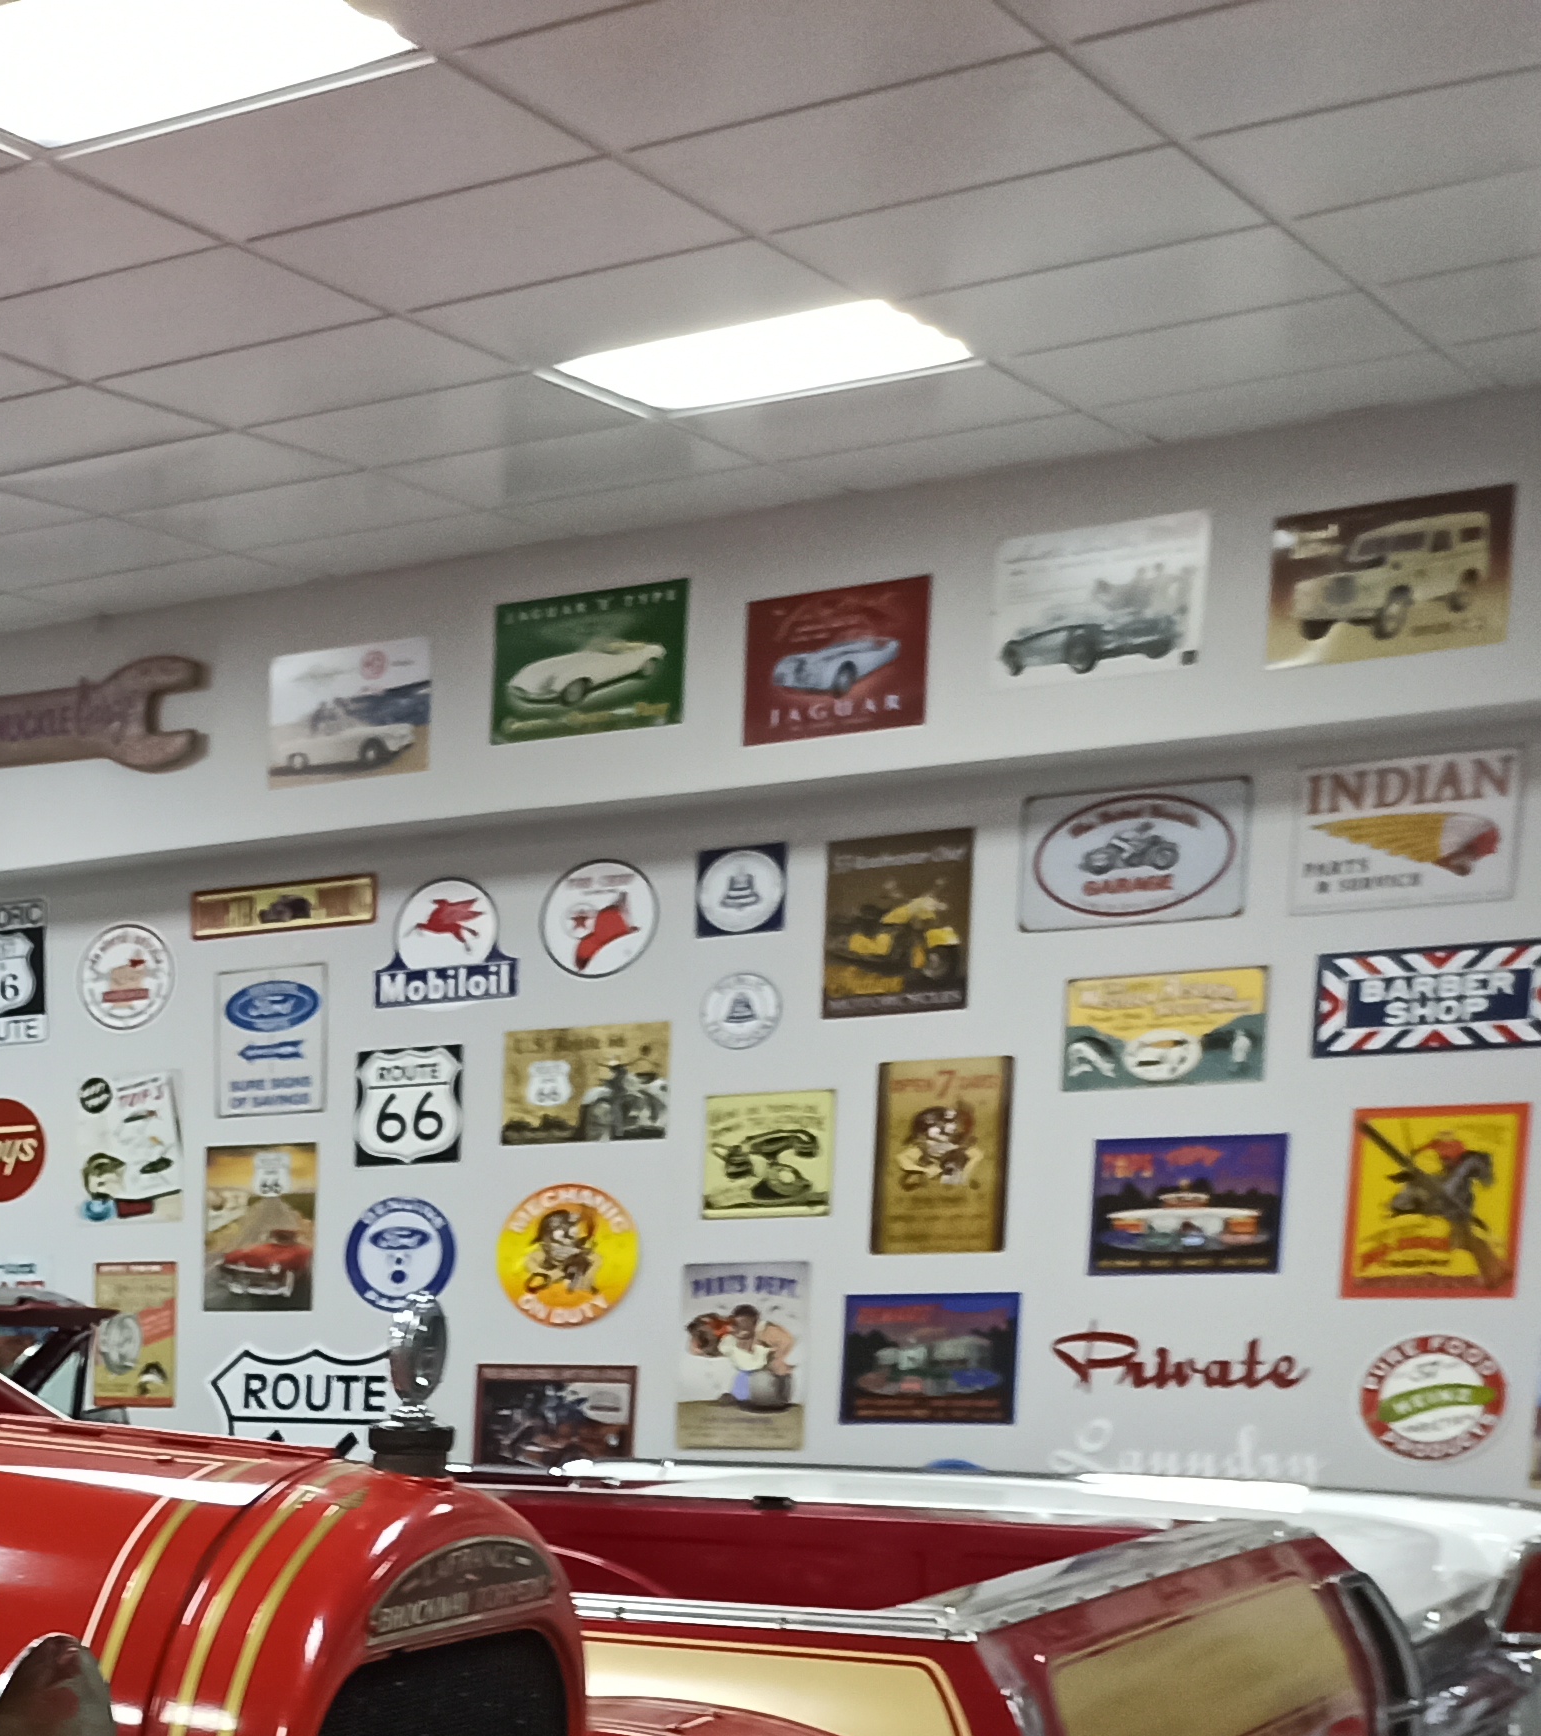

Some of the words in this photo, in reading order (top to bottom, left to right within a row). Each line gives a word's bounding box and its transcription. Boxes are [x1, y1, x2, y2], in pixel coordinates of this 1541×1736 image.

[768, 693, 903, 729] JAGUAR
[1306, 754, 1515, 816] INDIAN
[378, 964, 511, 1004] Mobiloil
[1359, 972, 1515, 1004] BARBER
[1383, 997, 1491, 1026] SHOP
[376, 1062, 440, 1083] ROUTE
[935, 1069, 957, 1099] 7
[376, 1091, 444, 1144] 66
[509, 1186, 631, 1234] MECHANIC
[1051, 1330, 1311, 1389] Private
[1428, 1335, 1499, 1377] FOOD
[242, 1372, 388, 1413] ROUTE
[1047, 1416, 1328, 1483] Laundry
